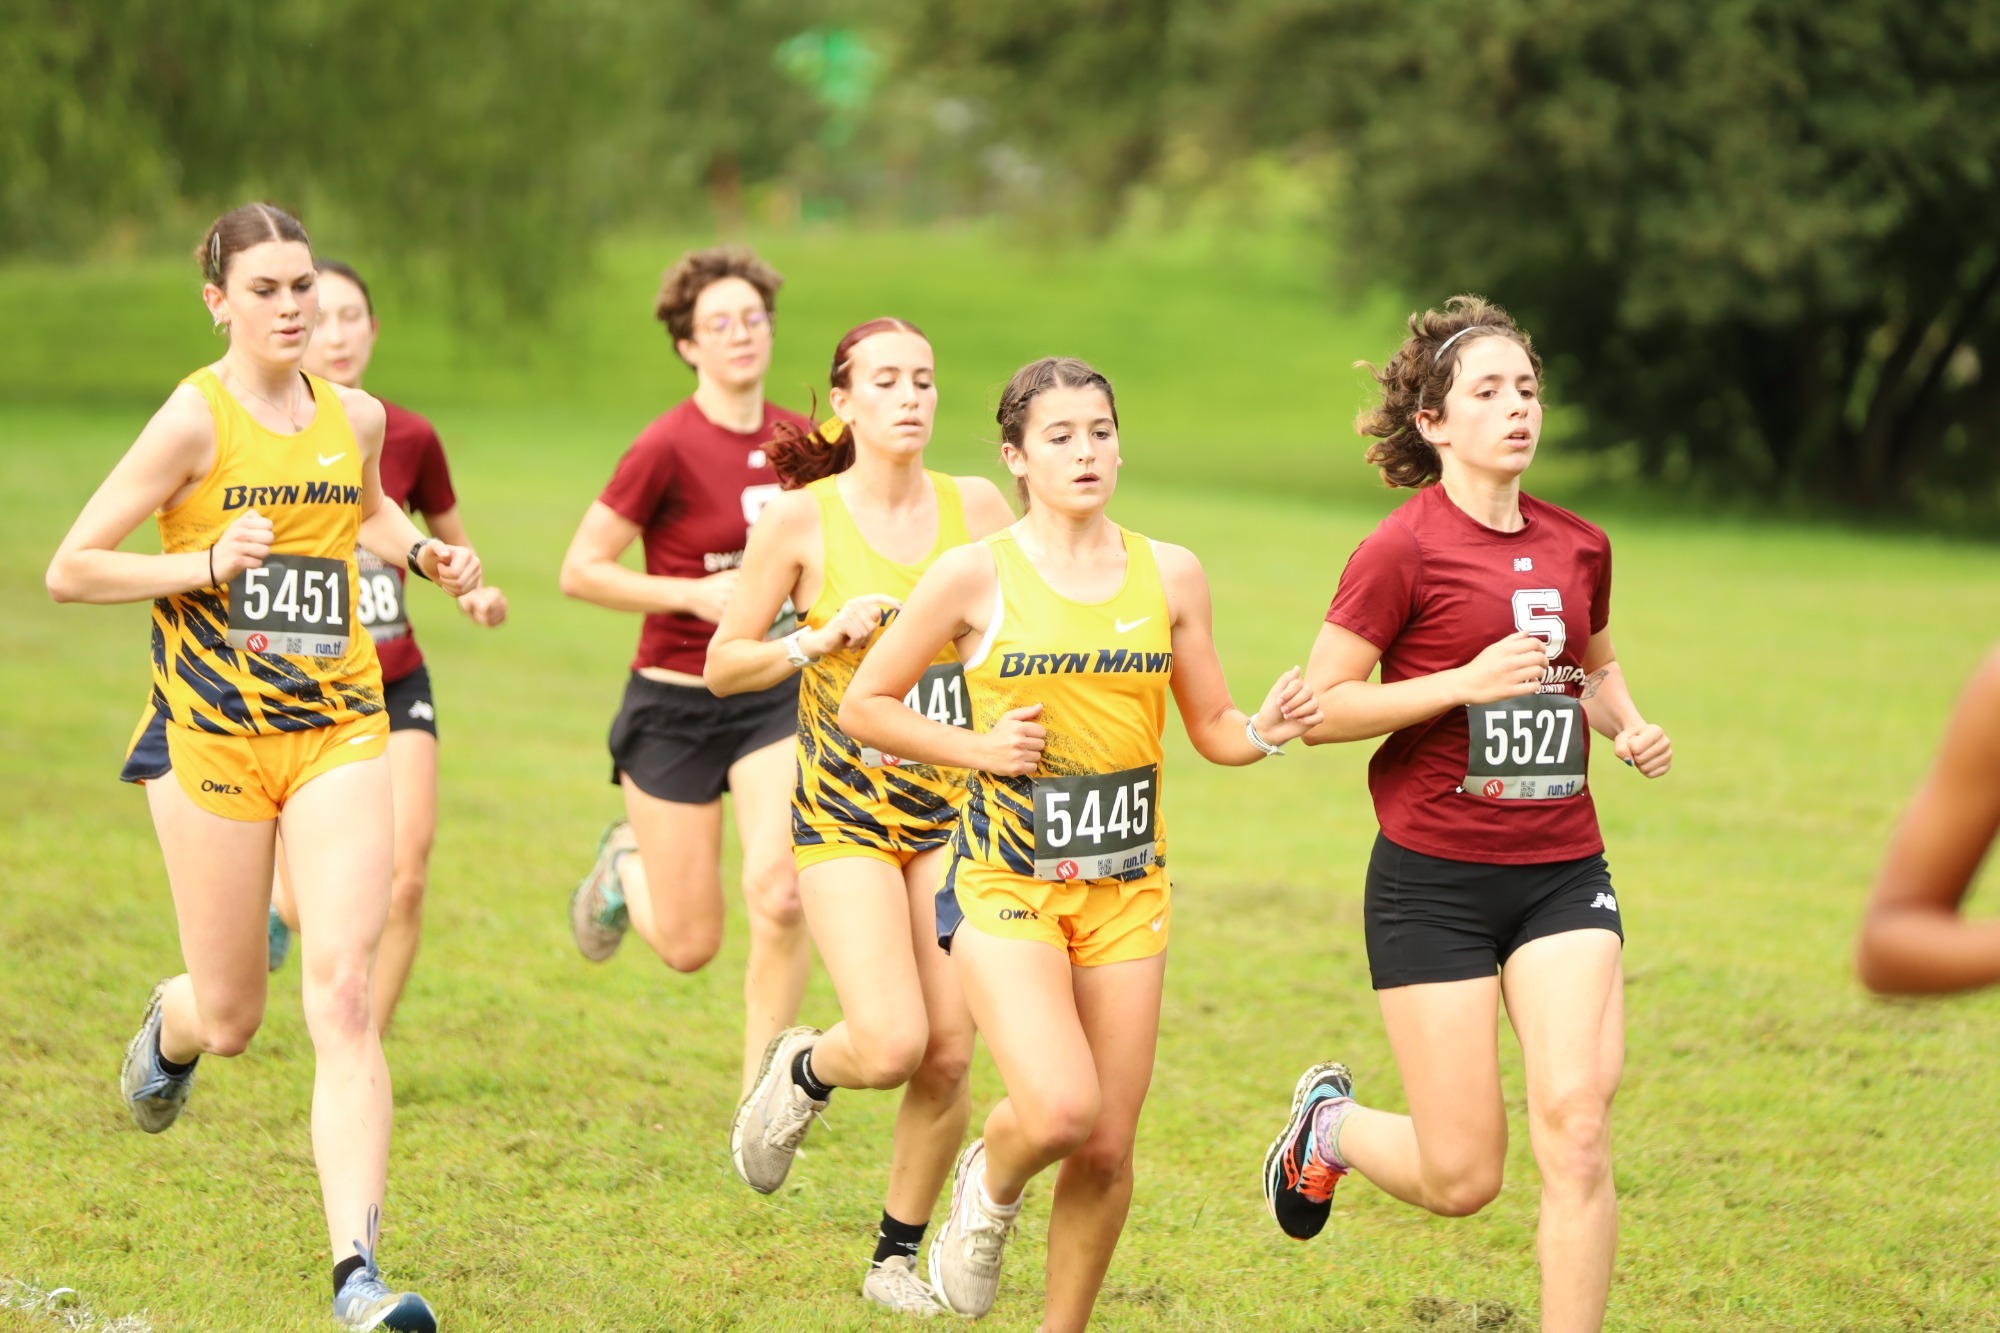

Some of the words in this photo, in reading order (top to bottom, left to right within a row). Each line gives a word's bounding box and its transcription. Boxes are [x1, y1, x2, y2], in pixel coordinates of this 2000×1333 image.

[222, 485, 299, 511] BRYN
[243, 568, 343, 625] 5451
[1512, 589, 1566, 660] S
[249, 635, 265, 652] NT
[315, 641, 341, 655] run.tf
[1000, 652, 1090, 678] BRYN
[1485, 709, 1574, 766] 5527
[1486, 781, 1501, 796] NT
[1547, 781, 1575, 796] run.tf
[1045, 780, 1150, 848] 5445
[1059, 861, 1075, 878] NT
[1123, 850, 1148, 870] run.tf
